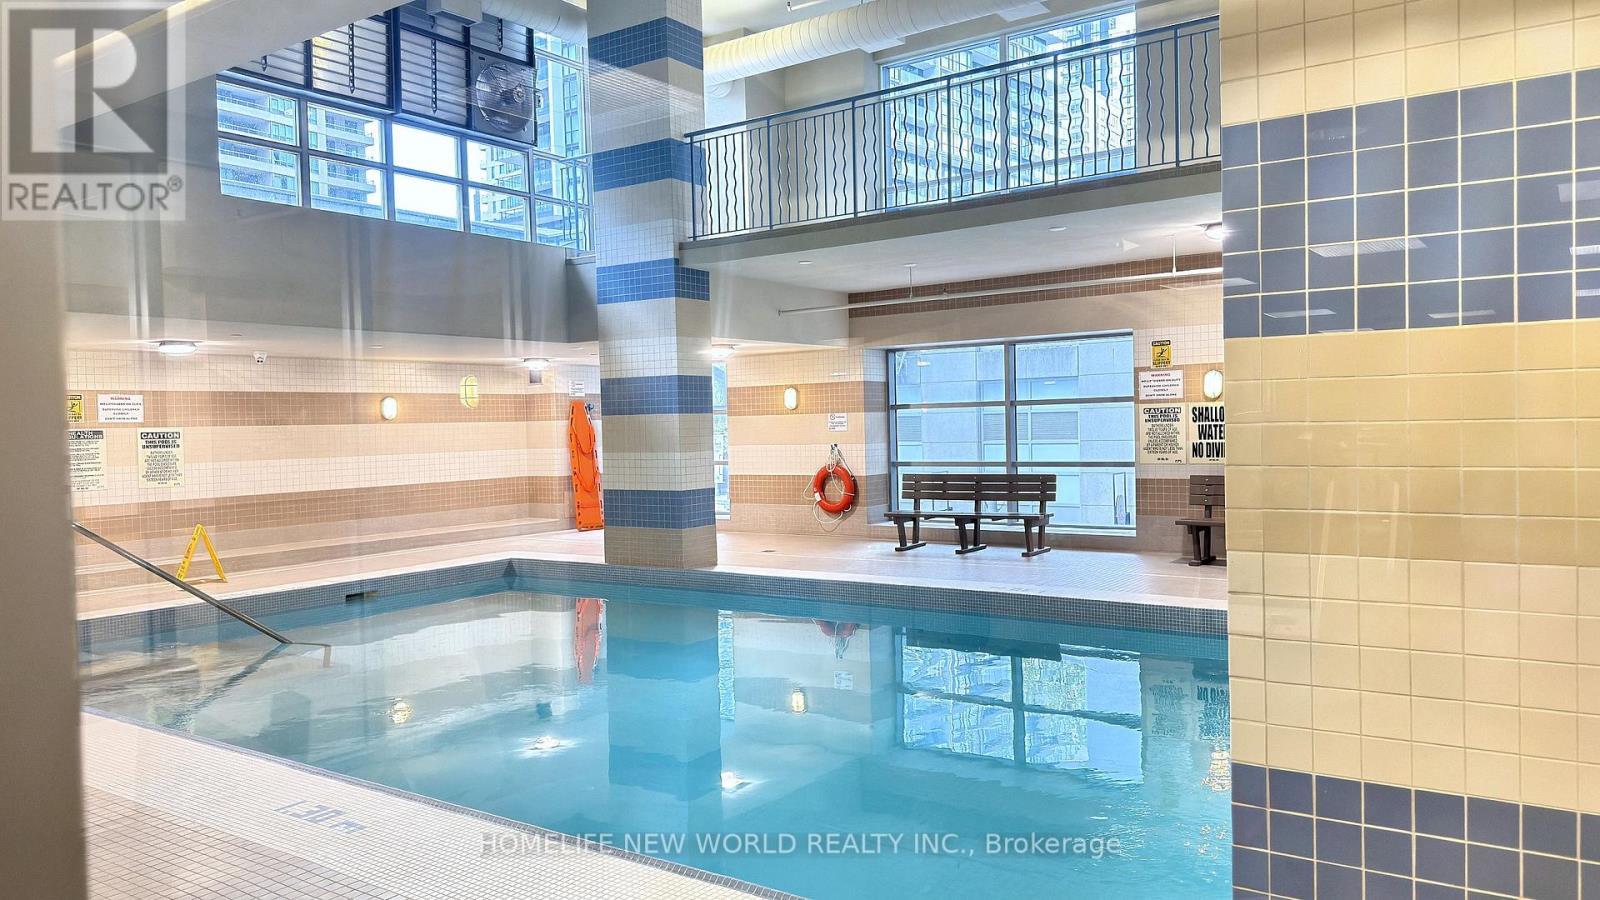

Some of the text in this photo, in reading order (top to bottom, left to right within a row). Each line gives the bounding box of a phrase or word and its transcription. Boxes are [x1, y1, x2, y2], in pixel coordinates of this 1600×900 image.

[1192, 406, 1224, 422] SHALLO
[1198, 424, 1225, 440] WATE
[1192, 442, 1225, 458] NO DIVI
